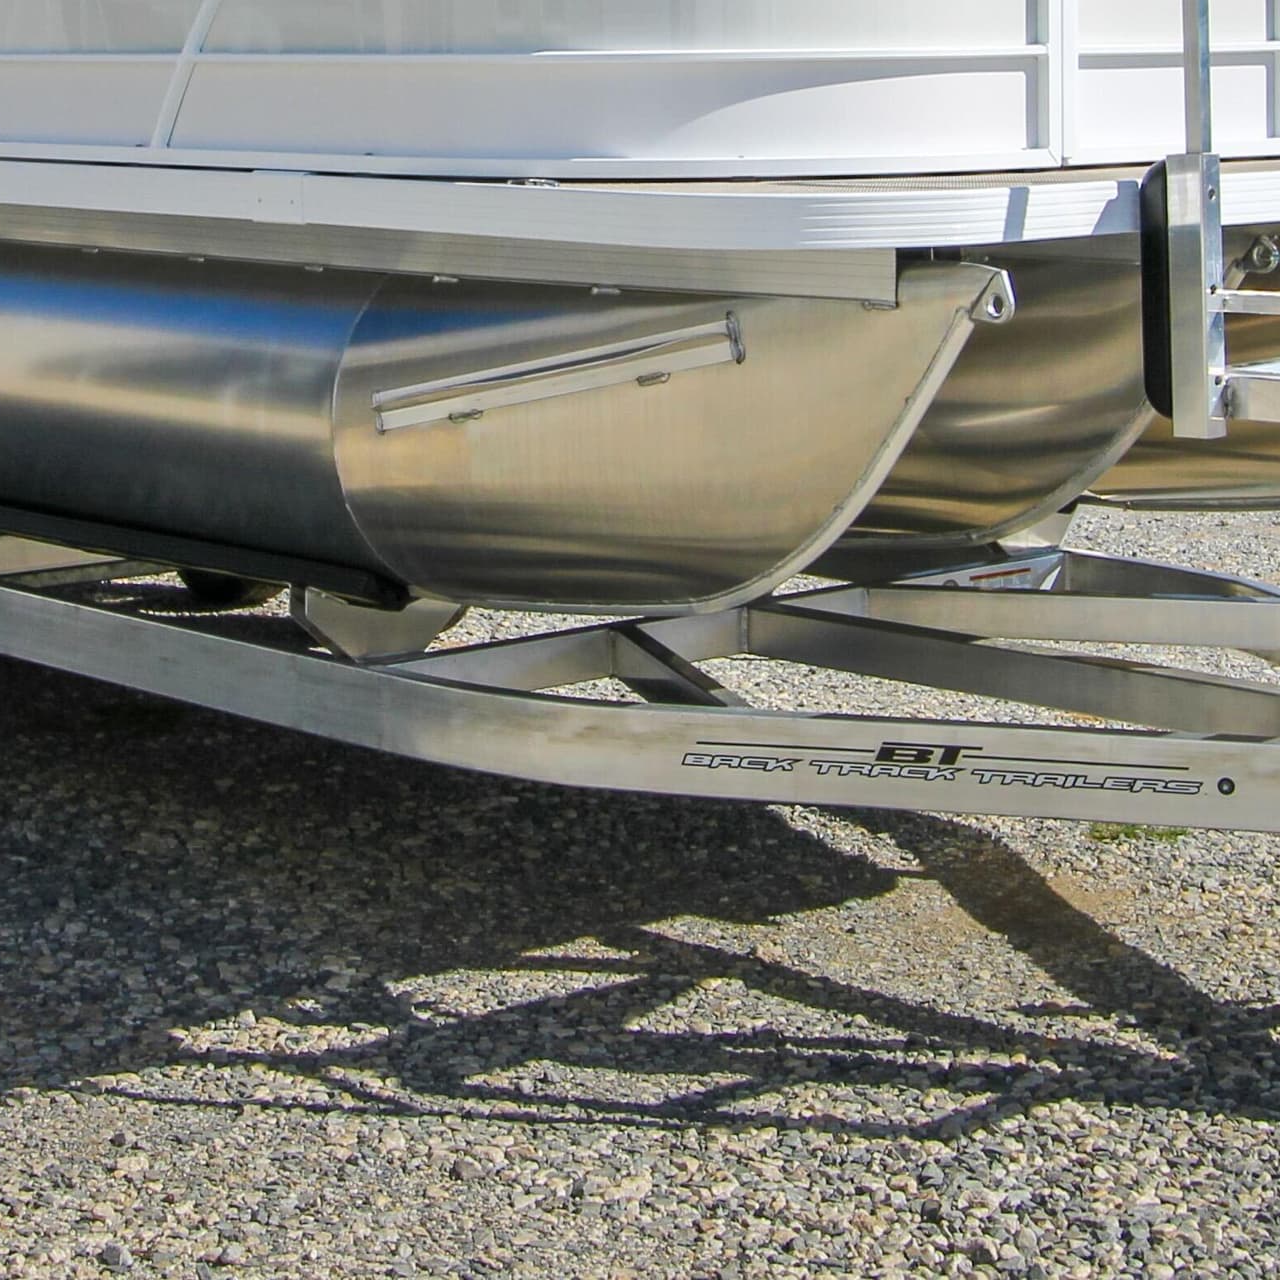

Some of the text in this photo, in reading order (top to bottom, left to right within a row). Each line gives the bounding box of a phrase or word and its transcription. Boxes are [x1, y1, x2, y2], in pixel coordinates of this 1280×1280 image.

[875, 742, 982, 766] BT
[681, 753, 1203, 795] BACK TRACK TRAILERS
